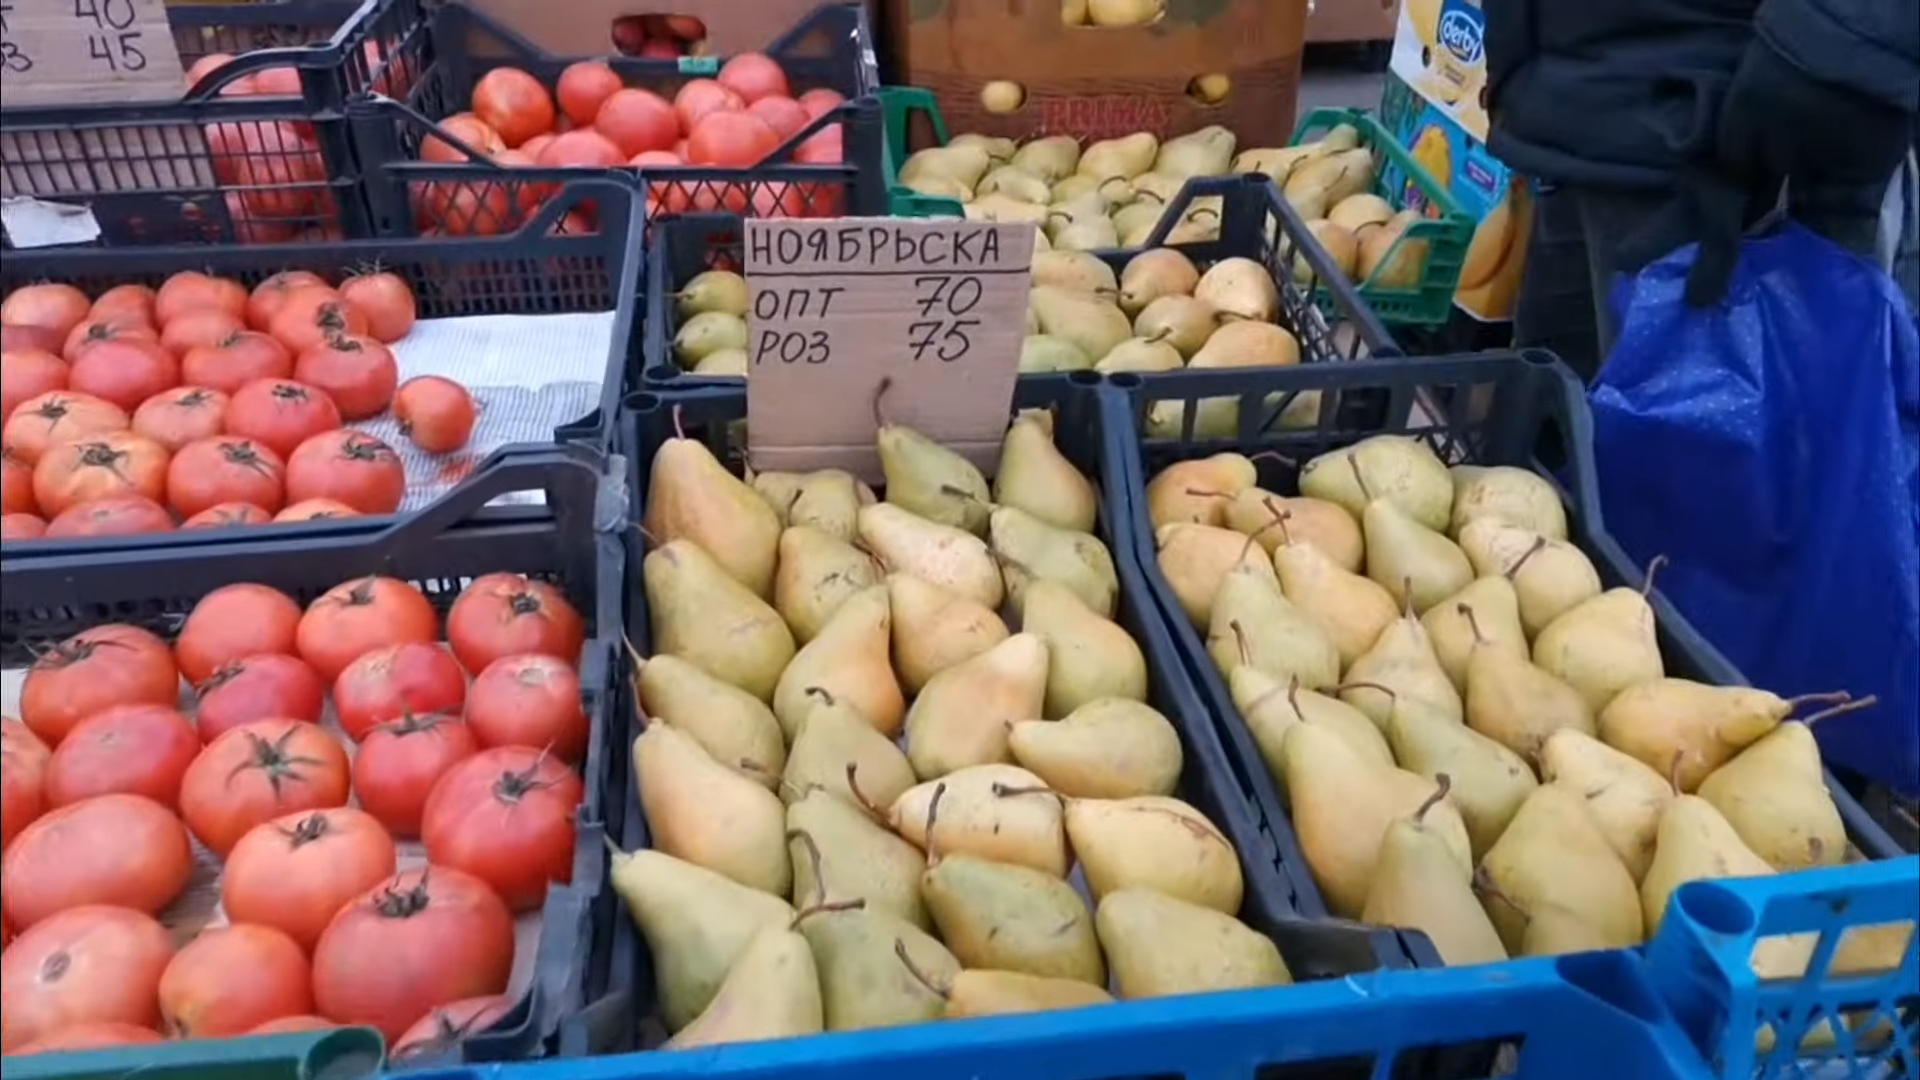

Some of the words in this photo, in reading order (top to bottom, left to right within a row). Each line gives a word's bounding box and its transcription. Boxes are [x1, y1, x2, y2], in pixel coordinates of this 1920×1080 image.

[75, 0, 136, 30] 40
[89, 32, 146, 71] 45
[1443, 14, 1482, 62] derby
[1042, 96, 1168, 134] PRIMA
[751, 227, 1000, 265] НОЯБРЬСКА
[754, 287, 845, 320] ОПТ
[914, 276, 982, 317] 70
[756, 330, 831, 364] РОЗ
[908, 320, 980, 362] 75
